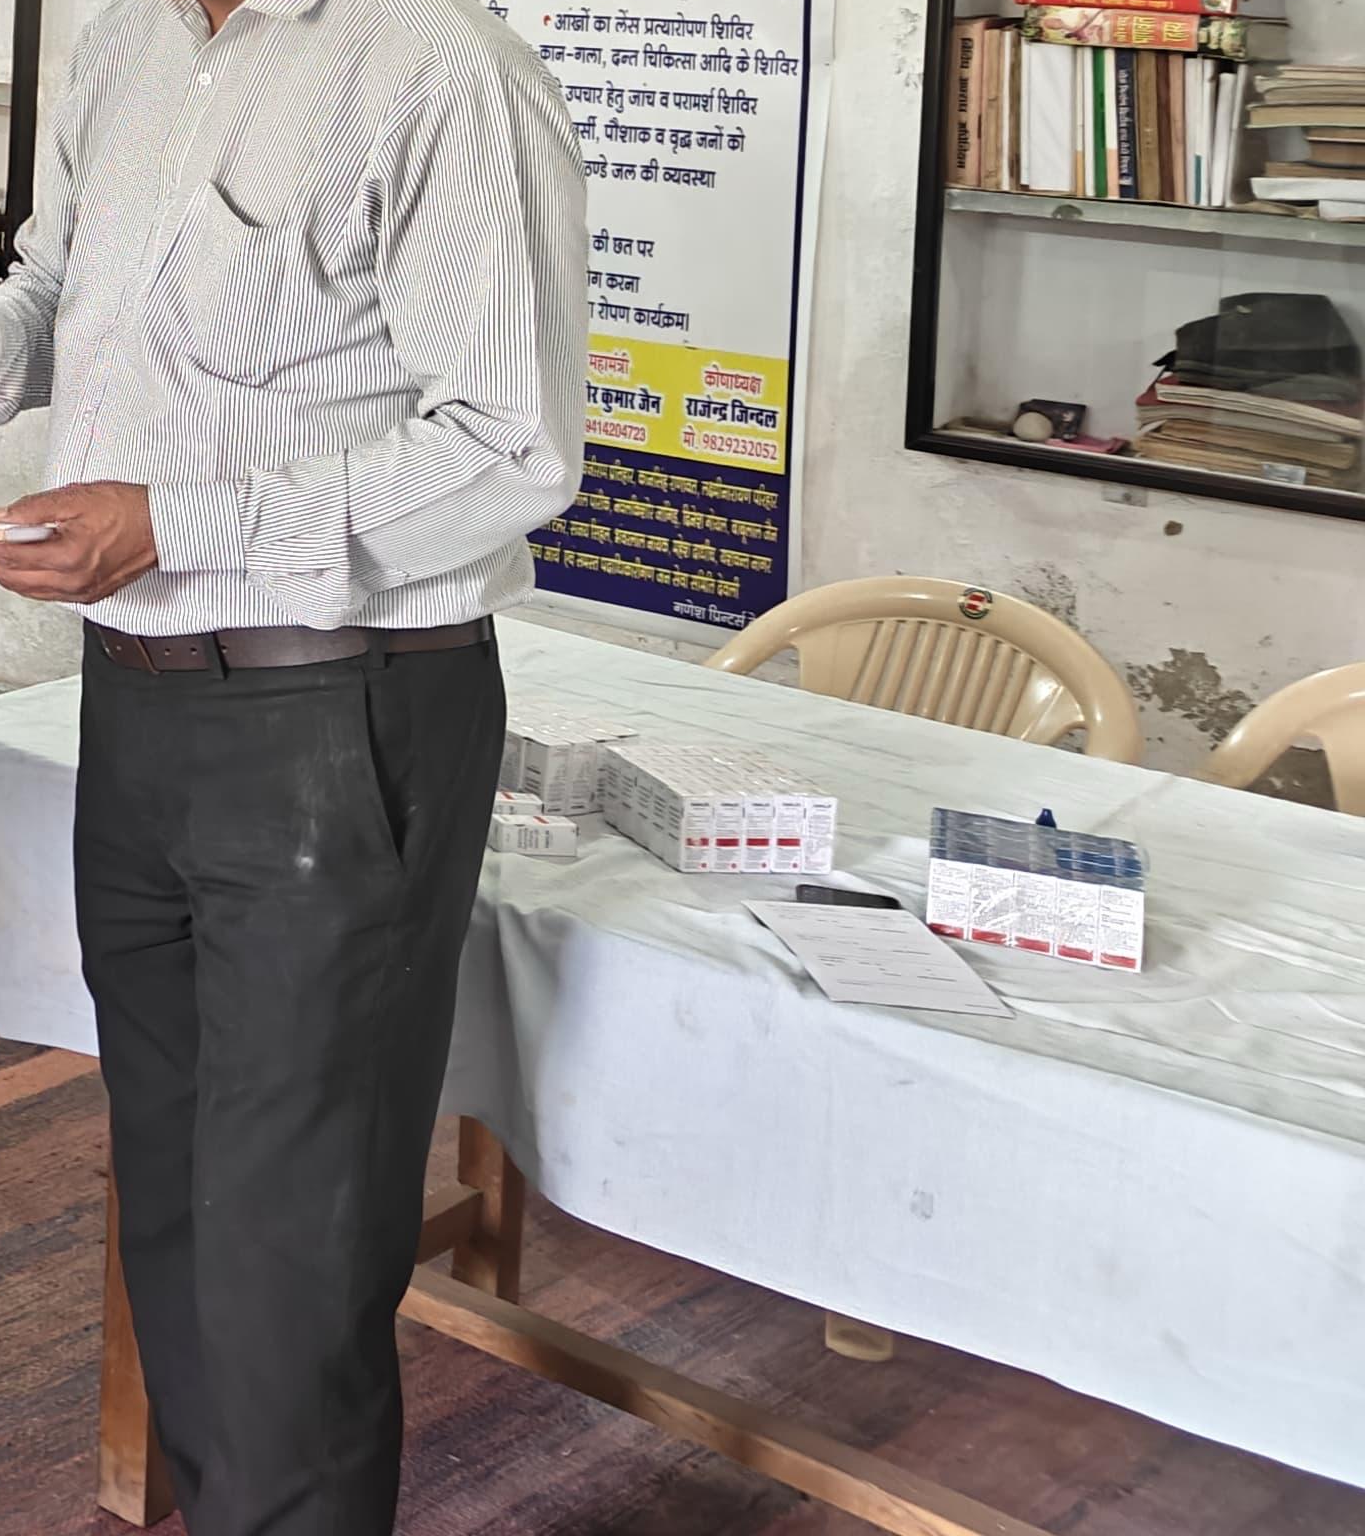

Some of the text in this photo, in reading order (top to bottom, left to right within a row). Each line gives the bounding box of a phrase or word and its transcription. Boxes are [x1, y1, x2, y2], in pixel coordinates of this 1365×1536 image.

[643, 12, 708, 39] प्रत्यारोपण
[710, 13, 755, 41] शिविर
[611, 48, 640, 68] दन्त
[643, 42, 698, 71] चिकित्सा
[700, 46, 733, 74] आदि
[736, 48, 751, 74] के
[754, 48, 800, 77] शिविर
[565, 85, 716, 113] उपचार परामर्श
[727, 126, 746, 153] को
[610, 157, 717, 189] जल की व्यवस्था
[612, 237, 656, 258] छत पर
[605, 273, 641, 294] करना
[597, 295, 631, 324] रोपण
[704, 364, 763, 395] कोषाध्यक्ष
[601, 387, 662, 414] कुमार जैन
[685, 395, 779, 429] राजेन्द्र जिन्दल
[702, 435, 778, 461] 9829232052
